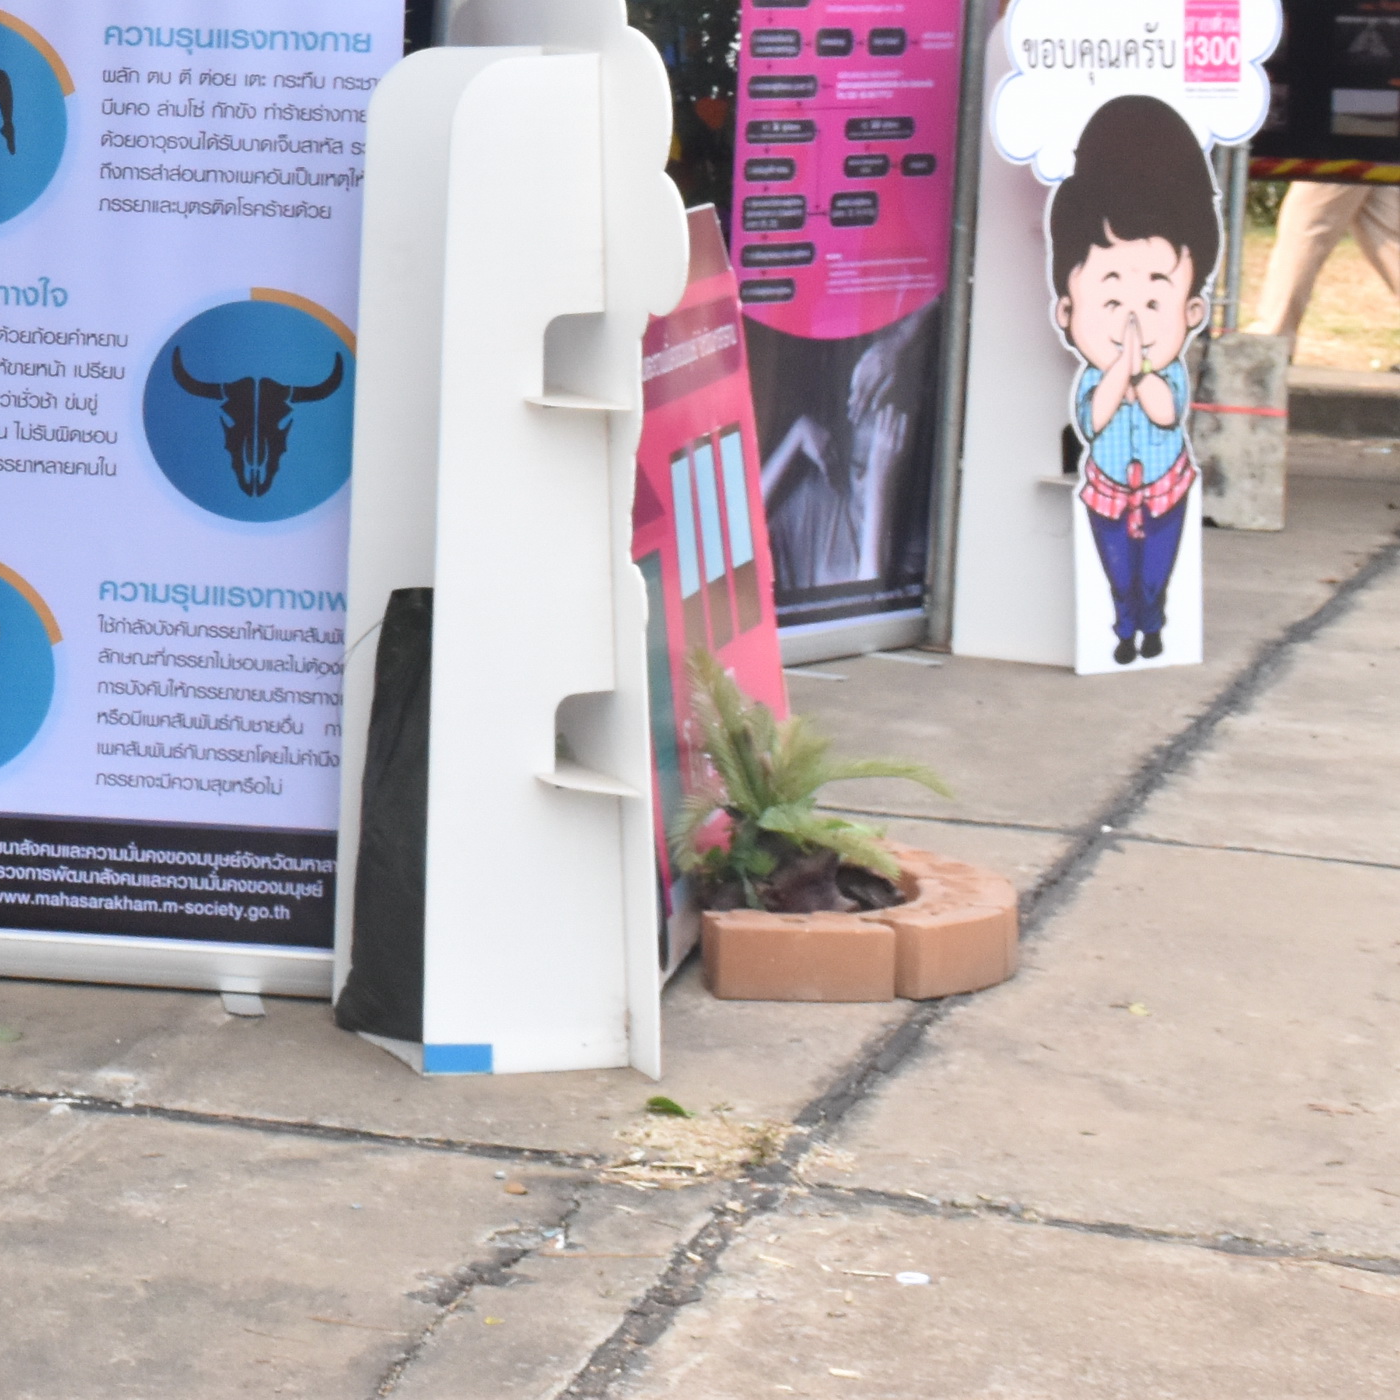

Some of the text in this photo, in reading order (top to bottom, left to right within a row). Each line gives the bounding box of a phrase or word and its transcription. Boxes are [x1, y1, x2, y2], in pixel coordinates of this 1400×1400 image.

[104, 25, 372, 56] ความรุนแรงทางกาย
[1185, 35, 1241, 67] 1300
[1022, 22, 1177, 85] ขอบคุณครับ
[102, 66, 382, 91] ผลัก ตบ ตี ต่อย เตะ กระทืบ กระชา
[101, 98, 150, 117] บีบคอ
[157, 98, 205, 119] ล่ามโซ่
[211, 102, 257, 120] กักขัง
[100, 130, 344, 155] ด้วยอาวุธจนได้รับบาดเจ็บสาหัส
[98, 197, 332, 220] ภรรยาและบุตรติดโรคร้ายด้วย
[74, 360, 126, 380] เปรียบ
[65, 391, 99, 416] ข่มขู่
[15, 420, 119, 445] ไม่รับผิดชอบ
[99, 579, 347, 613] ความรุนแรงทางเพ
[96, 706, 304, 736] หรือมีเพศสัมพันธ์กับชายอื่น
[95, 771, 283, 797] ภรรยาจะมีความสุขหรือไม่
